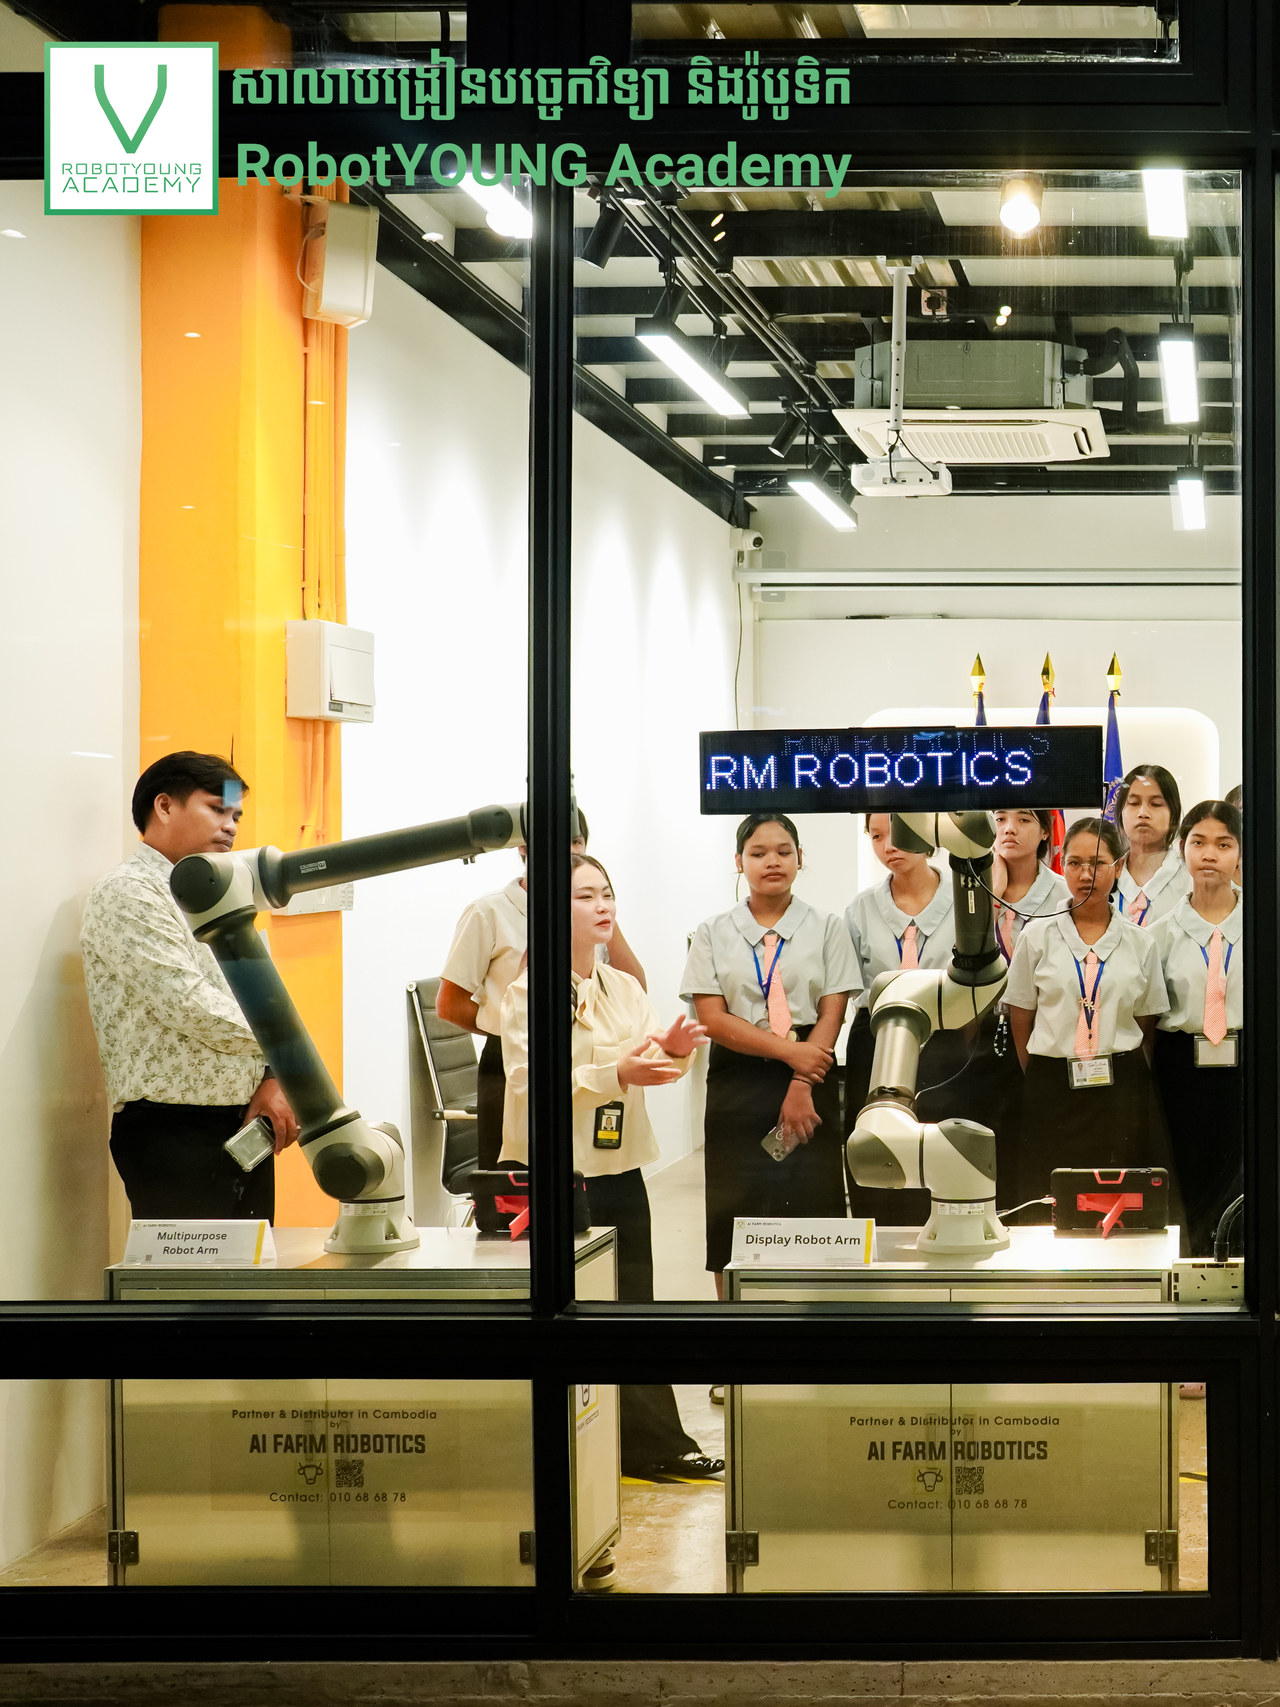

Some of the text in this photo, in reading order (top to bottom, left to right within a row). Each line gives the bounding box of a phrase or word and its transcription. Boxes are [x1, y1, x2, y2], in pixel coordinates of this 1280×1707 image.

[706, 750, 1033, 790] RM ROBOTICS
[157, 1231, 228, 1242] Multipurpose
[745, 1234, 861, 1247] Display Robot Arm
[162, 1246, 219, 1255] Robot Arm
[232, 1409, 437, 1419] Partner & Distributor in Cambodia
[330, 1420, 341, 1430] by
[849, 1416, 1060, 1426] Partner & Distributor in Cambodia
[249, 1433, 426, 1454] AI FARM ROBOTICS
[867, 1440, 1048, 1460] AI FARM ROBOTICS
[269, 1492, 407, 1502] Contact: 010 68 68 78
[887, 1499, 1028, 1509] Contact: 010 68 68 78
